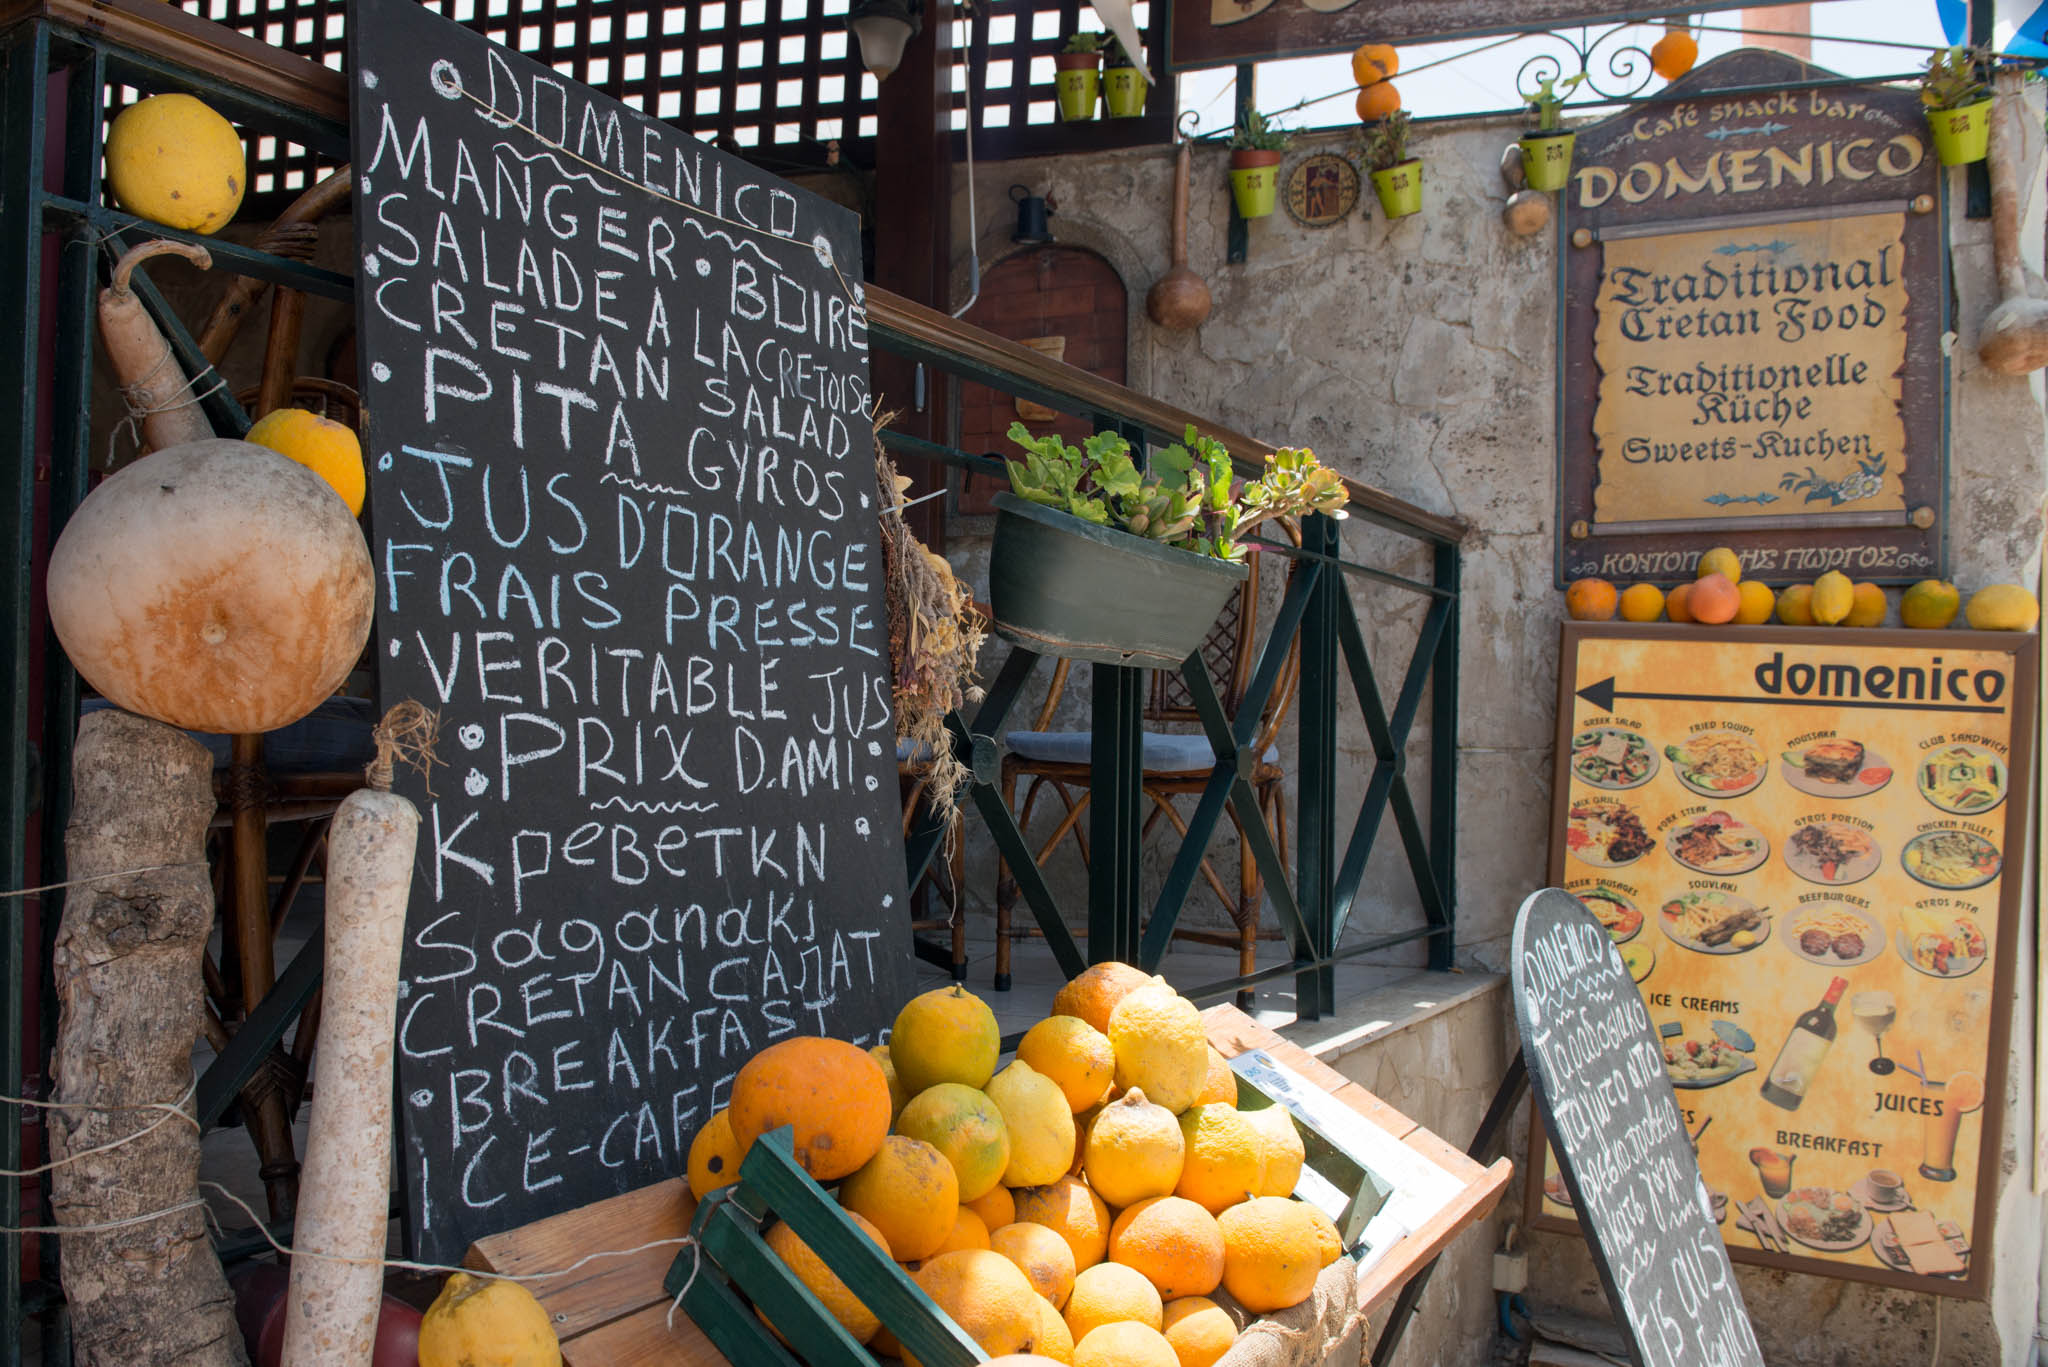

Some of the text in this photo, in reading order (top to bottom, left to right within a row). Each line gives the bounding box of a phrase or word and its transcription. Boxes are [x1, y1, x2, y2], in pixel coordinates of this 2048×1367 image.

[1633, 90, 1866, 141] Café snack bar
[475, 48, 797, 237] DOMENICO
[1574, 134, 1924, 209] DOMENICO
[368, 103, 869, 352] MANGER BOIRE
[377, 194, 627, 330] SALADE
[647, 285, 671, 348] A
[1610, 244, 1897, 307] Traditional
[1619, 293, 1887, 342] Cretan Food
[375, 277, 849, 460] CRETAN SALAD
[1625, 352, 1869, 397] Traditionelle
[1693, 389, 1813, 428] Küche
[424, 346, 845, 521] PITA GYROS
[400, 445, 869, 592] JUS D'ORANGE
[383, 538, 879, 658] FRAIS PRESSE
[416, 631, 890, 740] VERITABLE JUS
[1754, 652, 2006, 704] domenico
[1583, 717, 1642, 729] GREEK SALAD
[1689, 721, 1755, 736] FRIED SQUIDS
[1787, 730, 1837, 749] MOUSSAKA
[1919, 733, 2008, 754] CLUB SANDWICH
[500, 712, 709, 802] PRIX
[1593, 796, 1620, 805] GRILL
[1657, 805, 1708, 832] PORK STEAK
[1794, 813, 1876, 832] GYROS PORTION
[1916, 820, 1994, 838] CHICKEN FILLET
[1595, 878, 1639, 896] SAUSAGES
[1688, 880, 1737, 892] SOUVLAKI
[1798, 892, 1871, 910] BEEFBURGERS
[1915, 898, 1979, 913] GYROS PITA
[400, 949, 691, 1060] CRETAN
[1650, 992, 1740, 1014] ICE CREAMS
[450, 992, 837, 1150] BREAKFAST
[1874, 1092, 1944, 1117] JUICES
[1776, 1130, 1883, 1158] BREAKFAST
